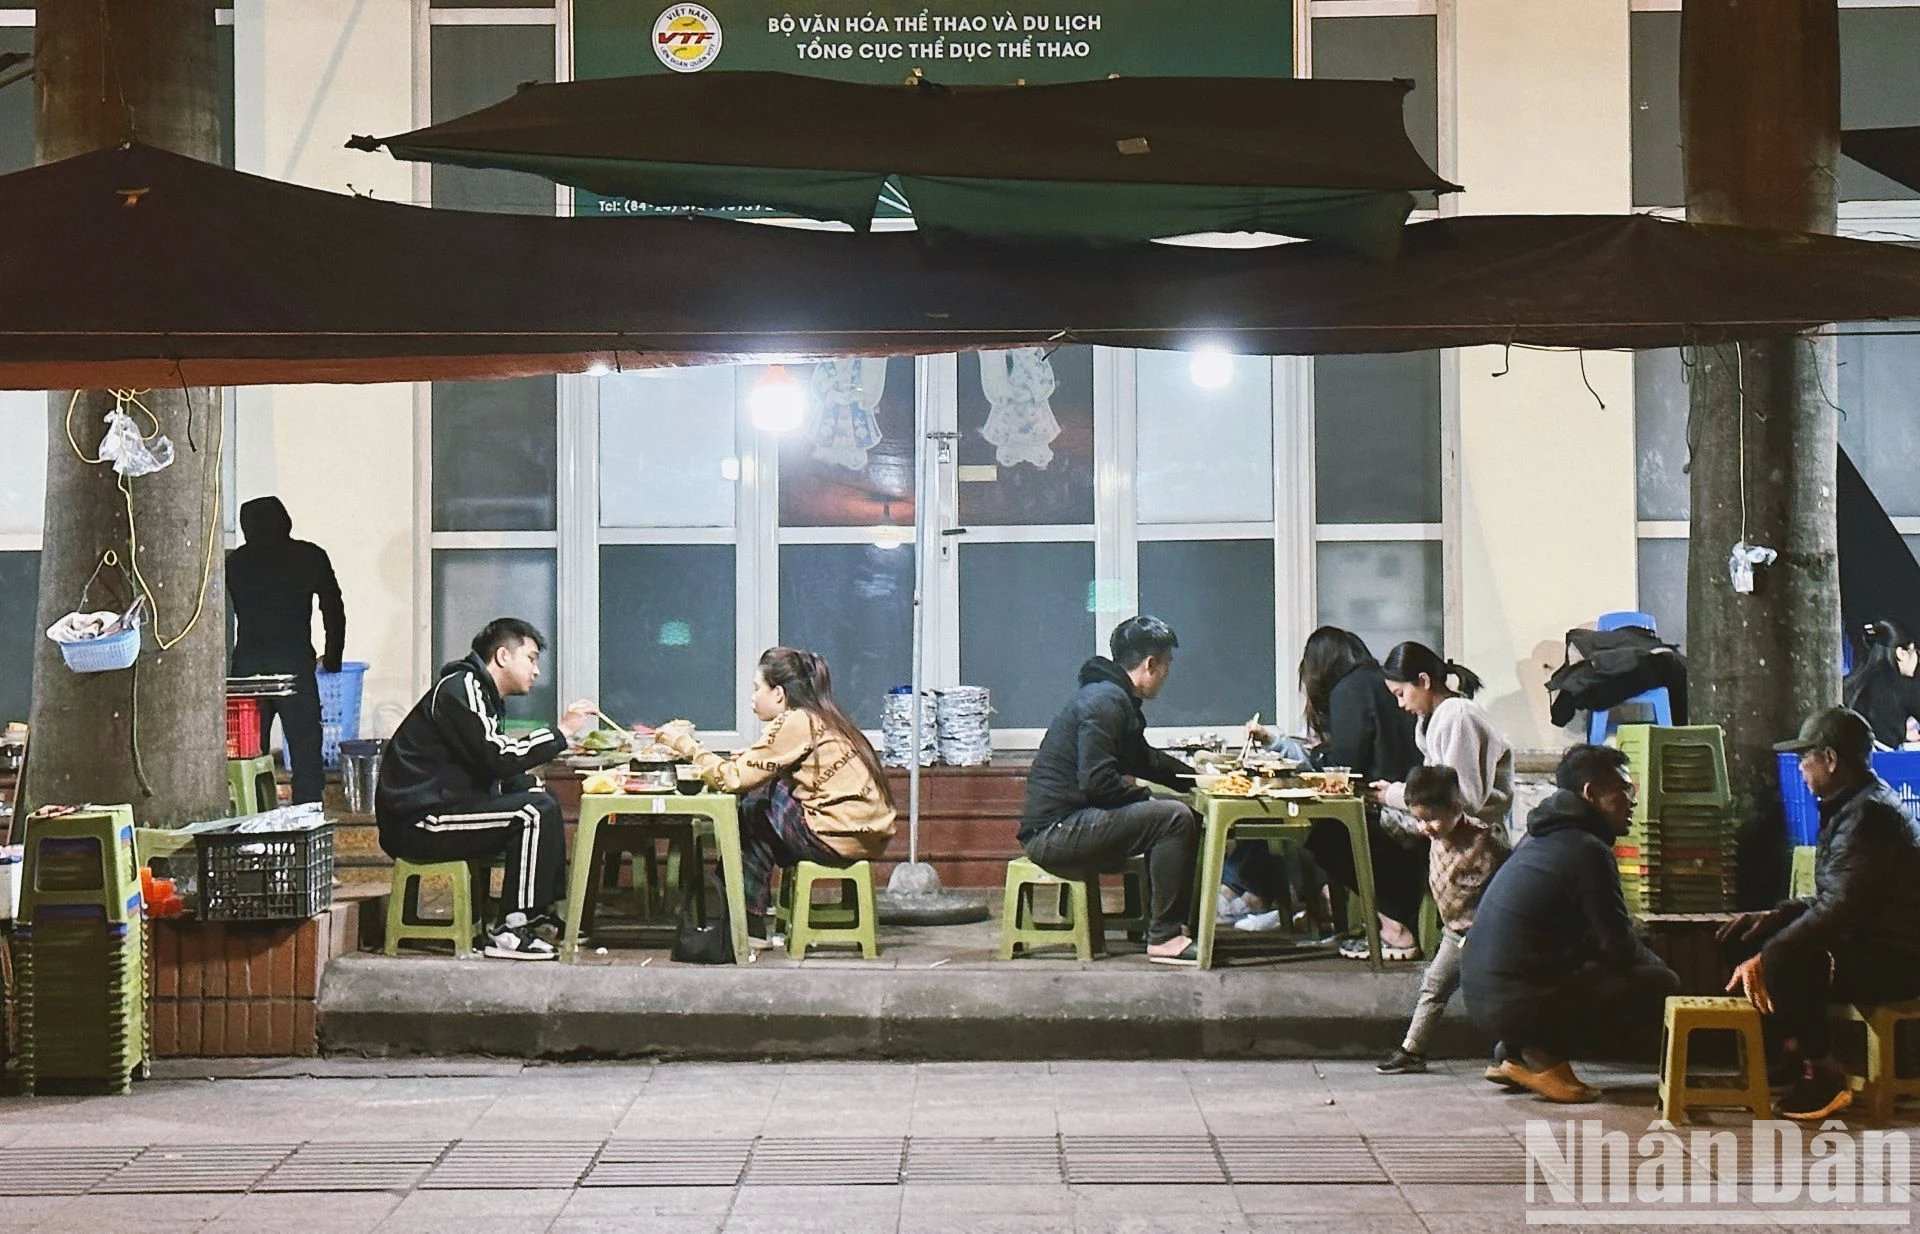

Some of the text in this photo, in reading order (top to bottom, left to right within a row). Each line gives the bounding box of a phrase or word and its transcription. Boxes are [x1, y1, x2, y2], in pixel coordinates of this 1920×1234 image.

[688, 8, 709, 21] NAM
[768, 8, 1101, 37] BỘ VĂN HÓA THỂ THAO VÀ DU LỊCH
[658, 32, 715, 44] VTF
[797, 34, 1090, 63] TỔNG CỤC THỂ DỤC THỂ THAO
[598, 201, 621, 212] Tel:
